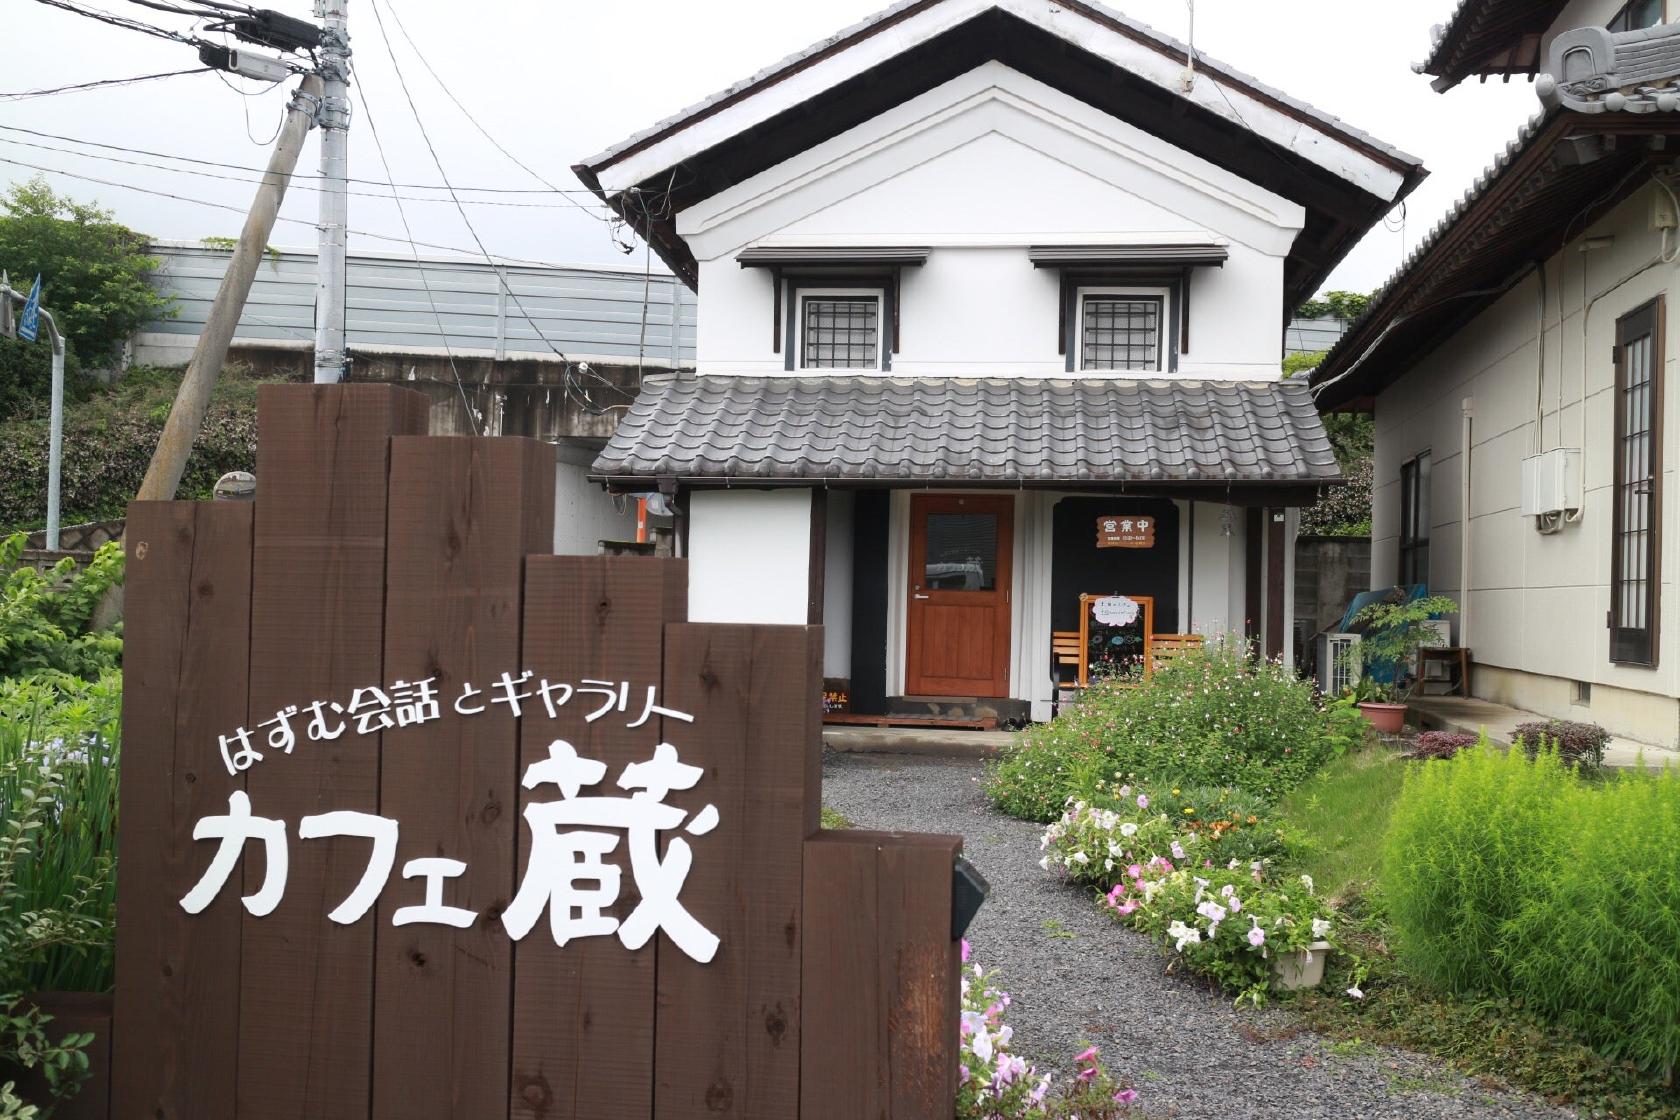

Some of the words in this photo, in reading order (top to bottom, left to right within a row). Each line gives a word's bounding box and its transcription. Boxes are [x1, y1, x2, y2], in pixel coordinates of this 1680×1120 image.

[1103, 519, 1149, 533] 営業中
[218, 671, 694, 775] はずむ会話とギャラリー
